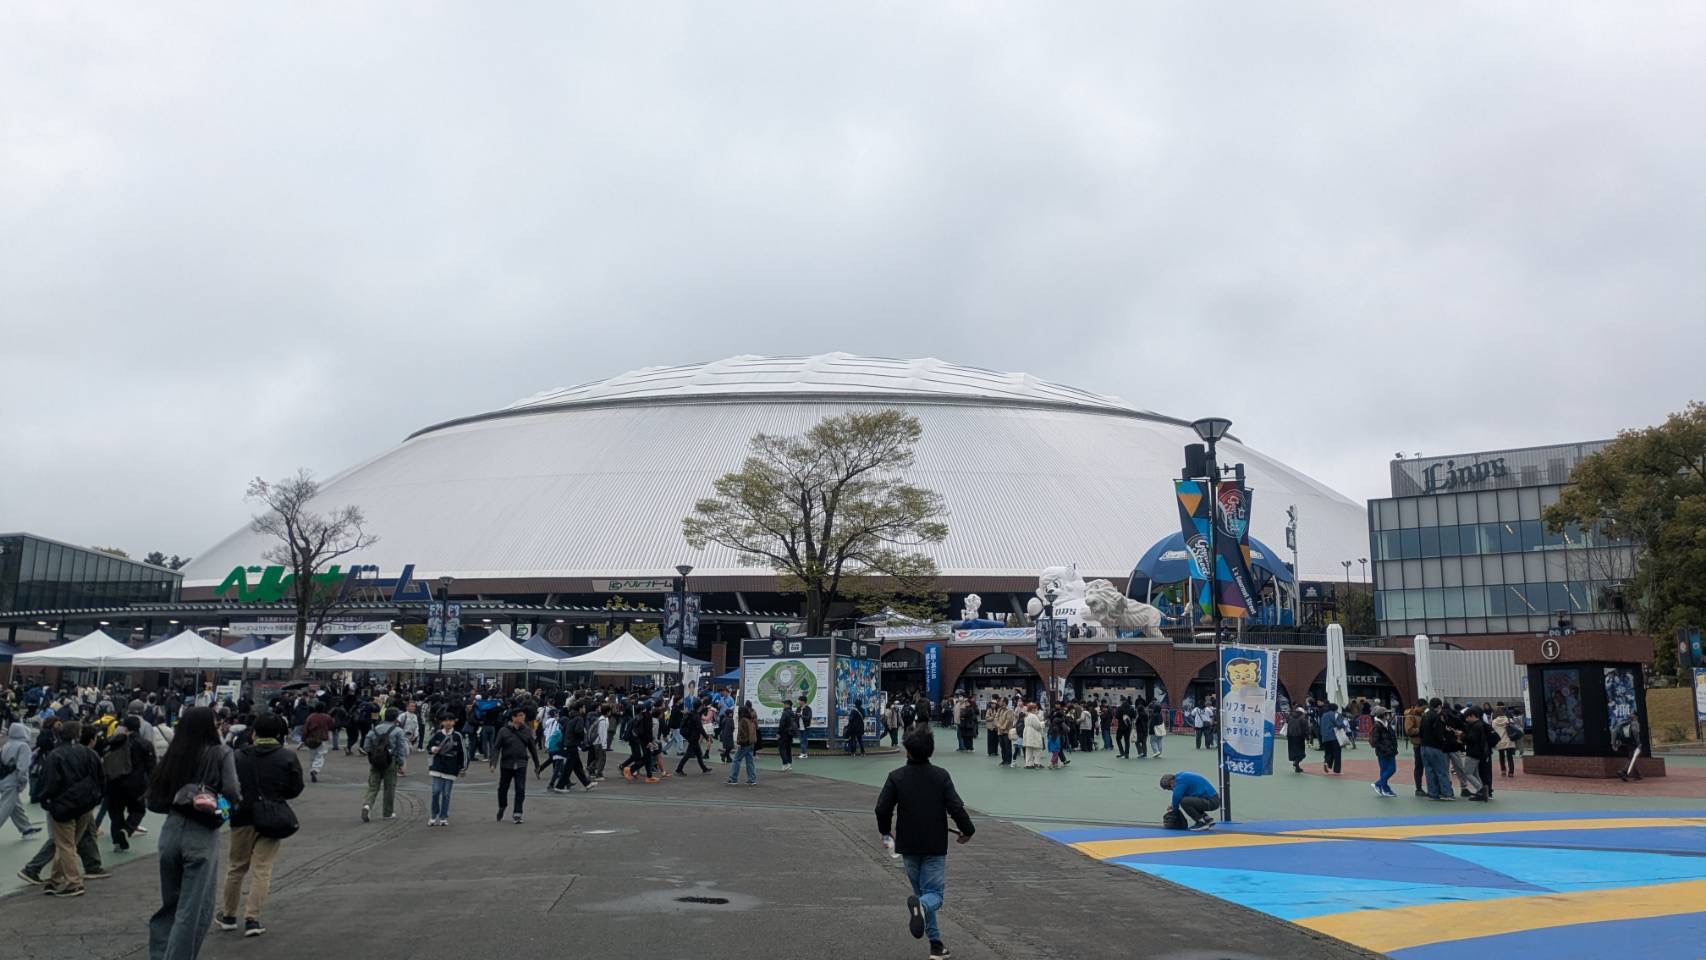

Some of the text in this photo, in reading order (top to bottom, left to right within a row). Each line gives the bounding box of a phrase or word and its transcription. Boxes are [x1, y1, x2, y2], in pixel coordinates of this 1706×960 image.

[1096, 666, 1129, 674] TICKET
[1347, 675, 1377, 683] TICKET
[1226, 702, 1261, 713] リフォーム
